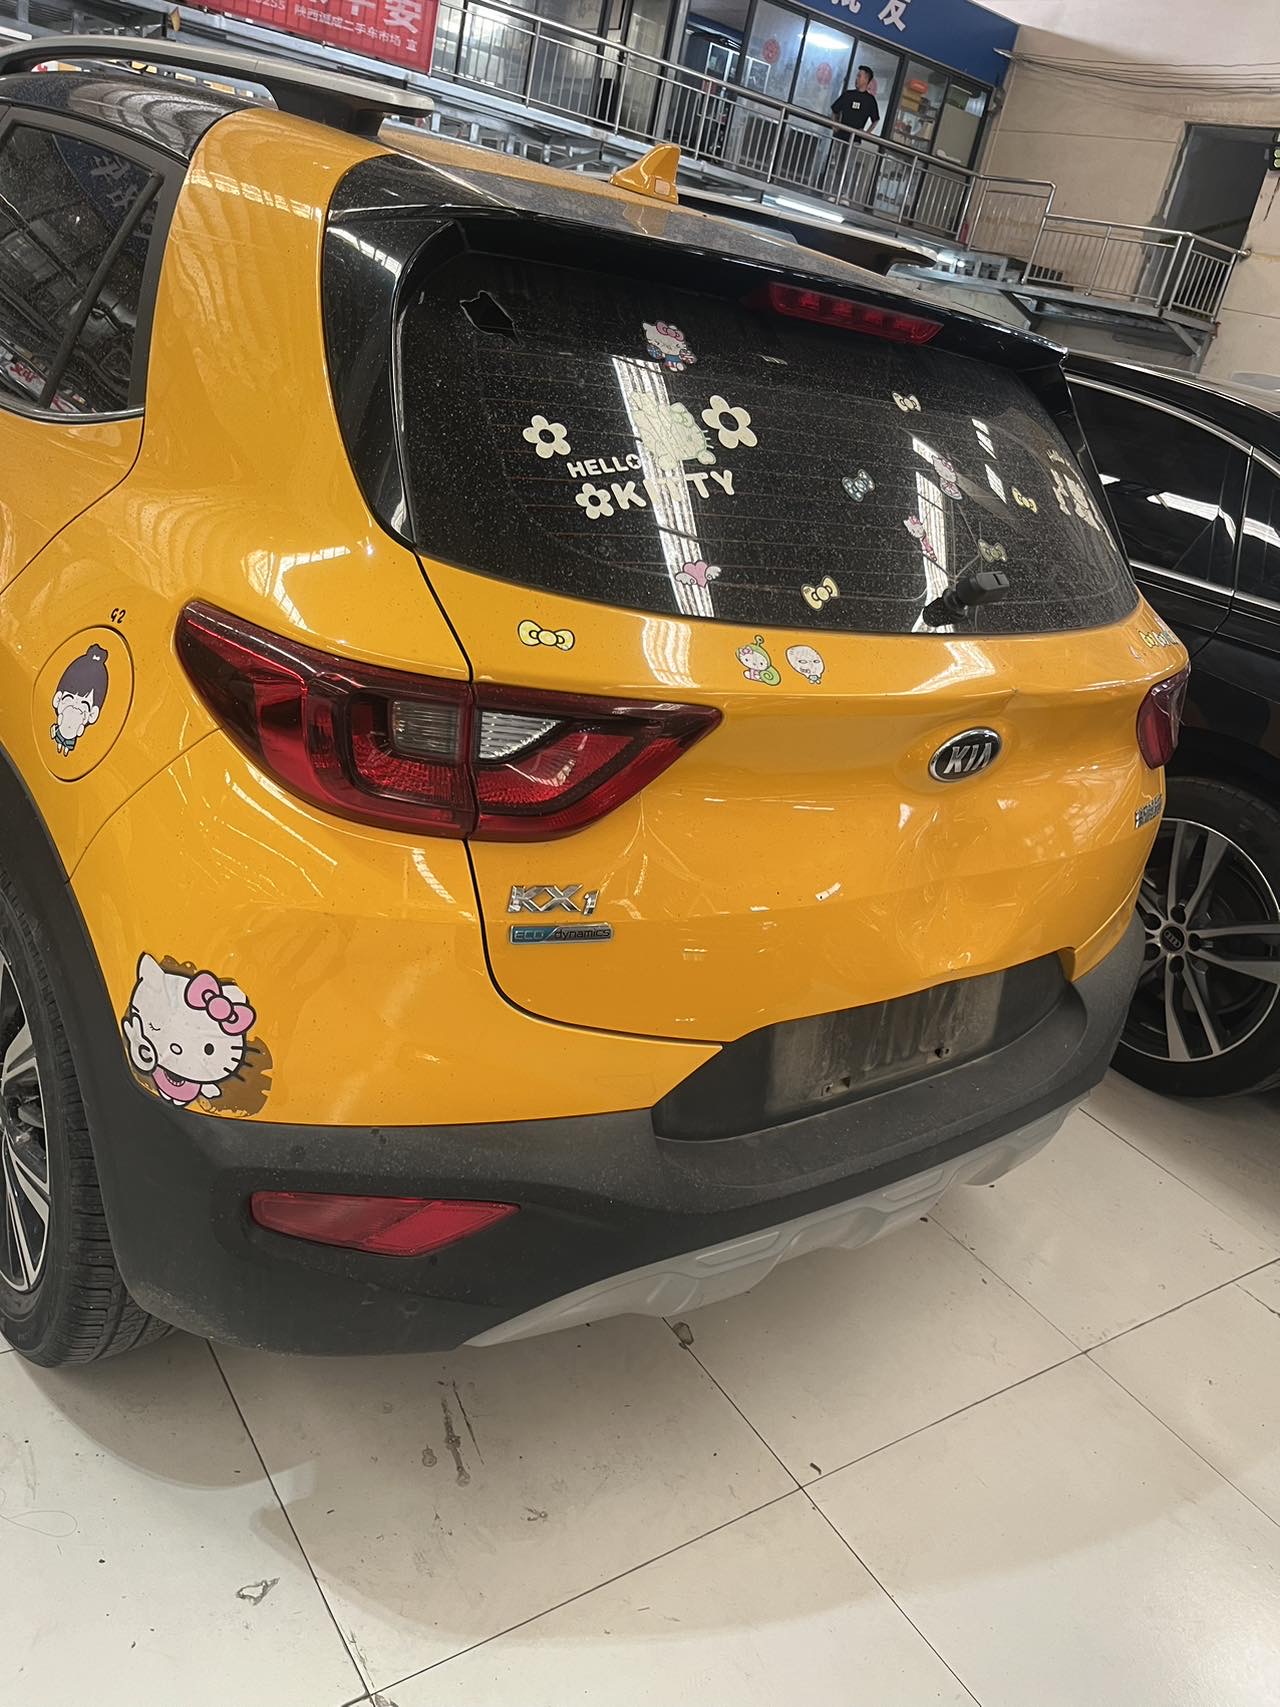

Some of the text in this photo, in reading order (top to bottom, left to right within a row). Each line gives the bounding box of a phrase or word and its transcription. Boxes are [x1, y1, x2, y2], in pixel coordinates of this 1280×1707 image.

[566, 453, 642, 479] HELLO
[943, 742, 993, 775] KIA
[555, 926, 611, 940] dynamics
